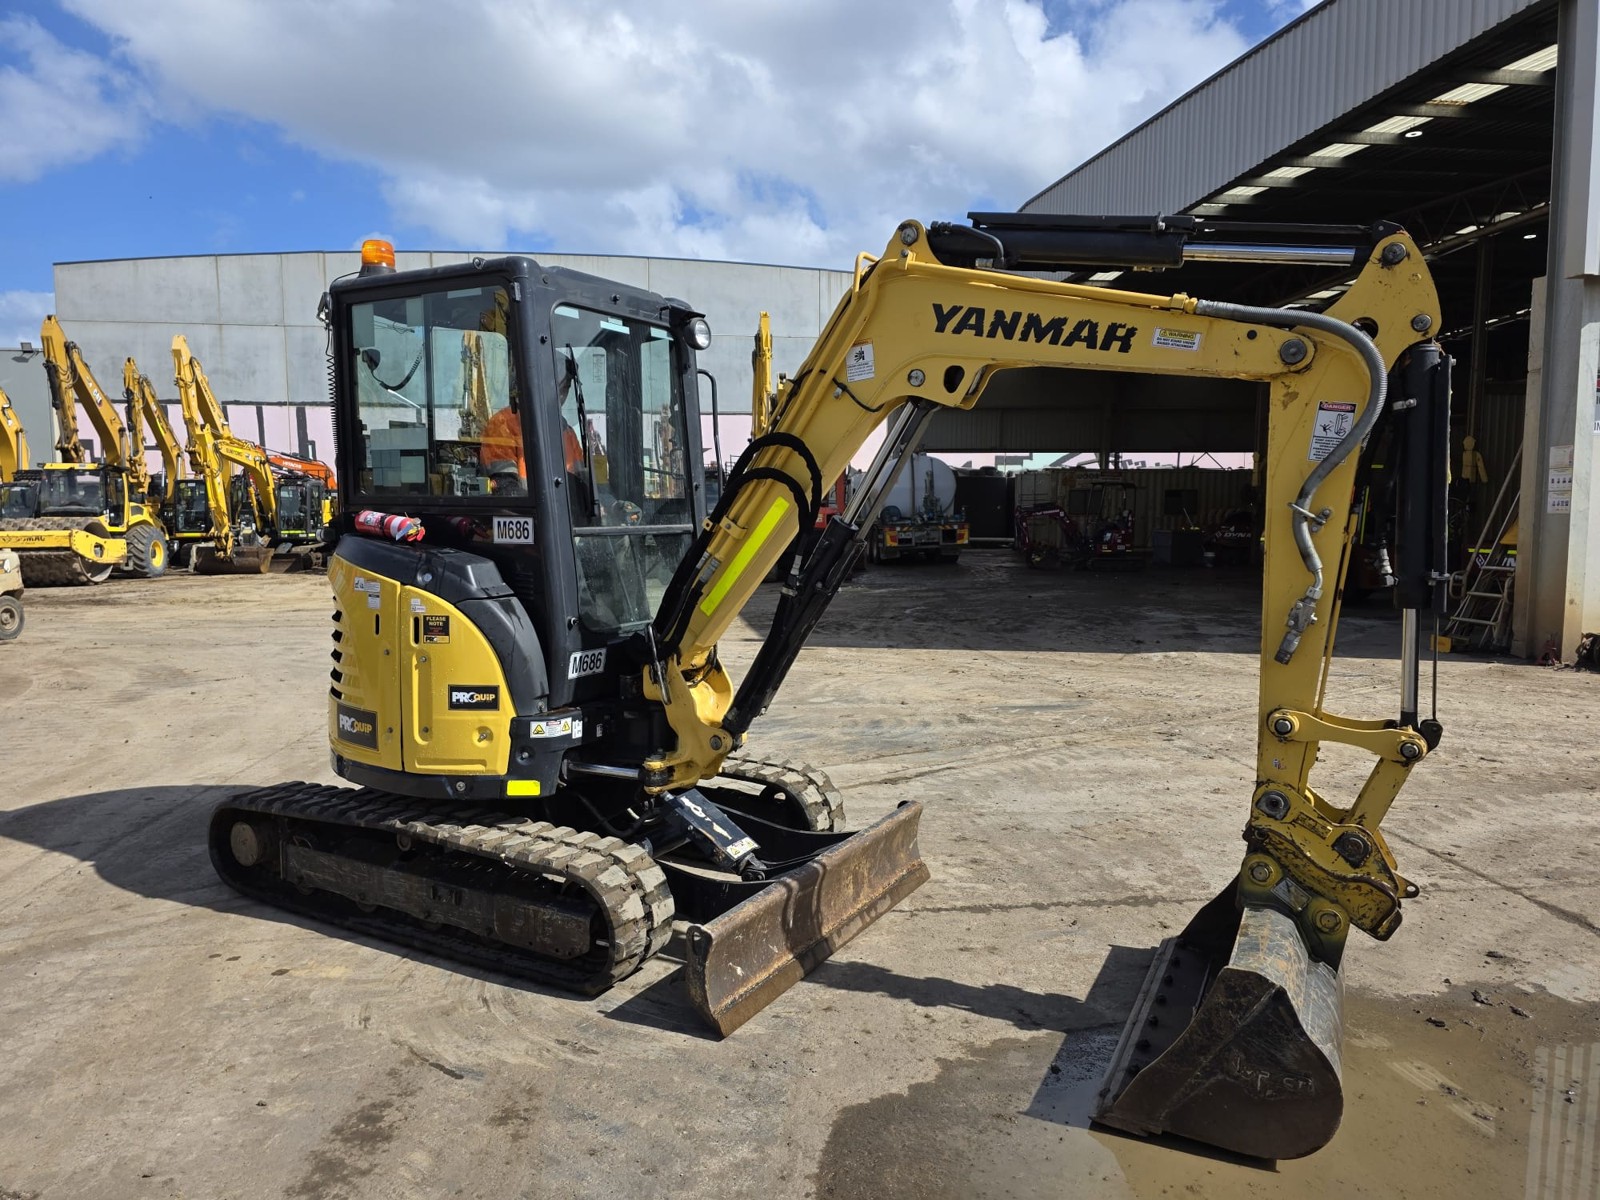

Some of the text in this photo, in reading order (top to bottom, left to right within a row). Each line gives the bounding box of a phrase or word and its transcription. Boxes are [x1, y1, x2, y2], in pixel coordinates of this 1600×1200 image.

[932, 303, 1138, 353] YANMAR
[1322, 403, 1352, 411] DANGER
[497, 520, 530, 540] M686
[571, 651, 603, 675] M686
